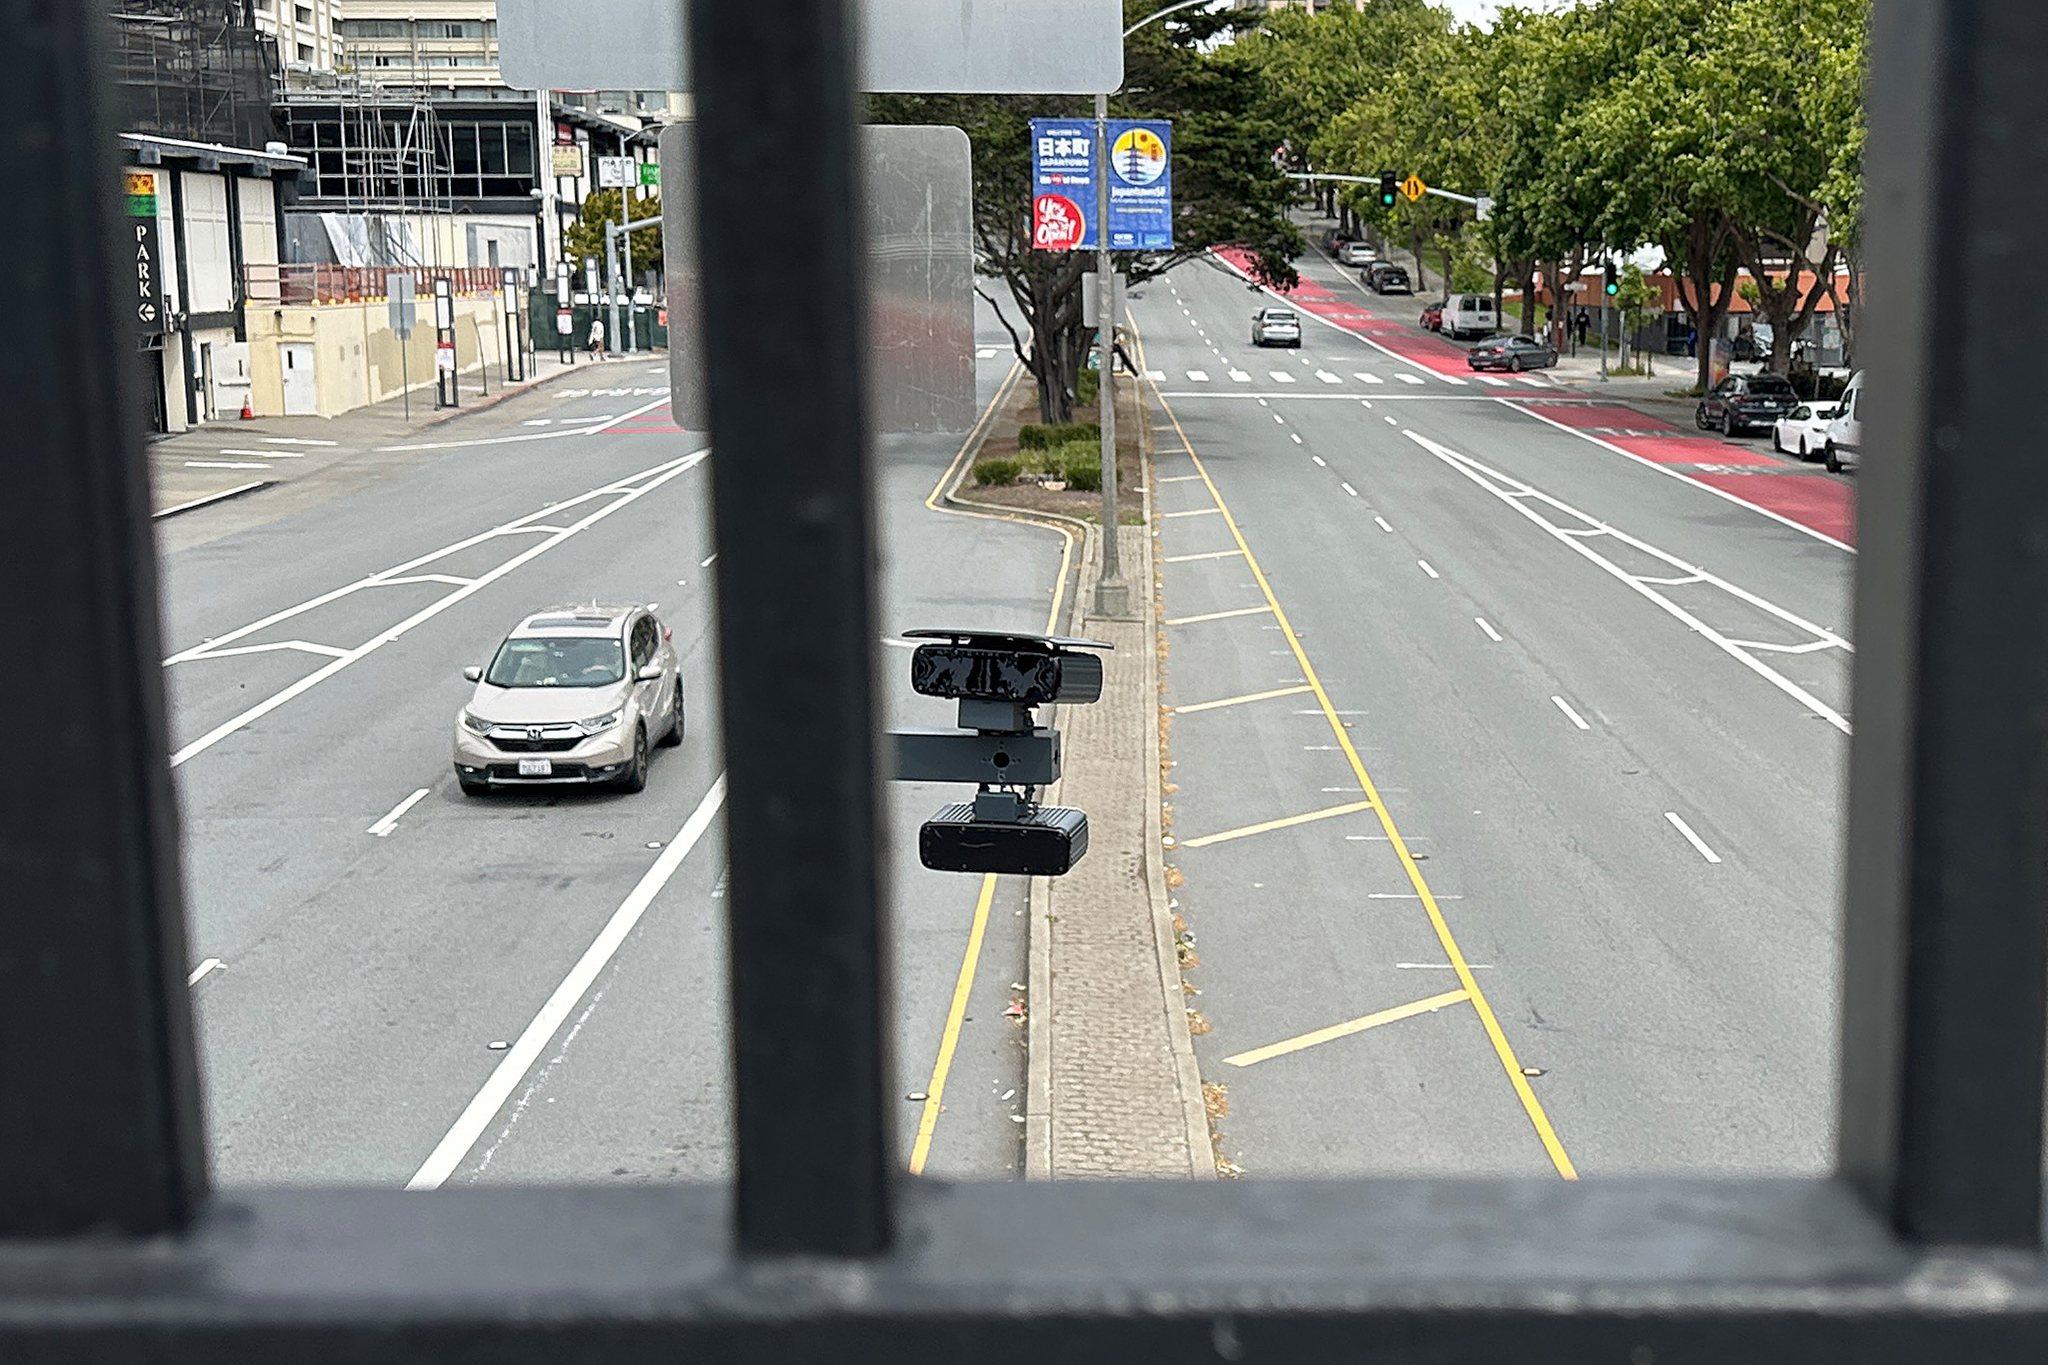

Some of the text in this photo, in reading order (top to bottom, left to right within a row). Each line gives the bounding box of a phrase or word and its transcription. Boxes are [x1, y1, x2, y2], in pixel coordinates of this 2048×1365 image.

[1038, 137, 1090, 157] 日本町
[1040, 158, 1090, 167] JAPANTOWN
[135, 225, 151, 298] PARK
